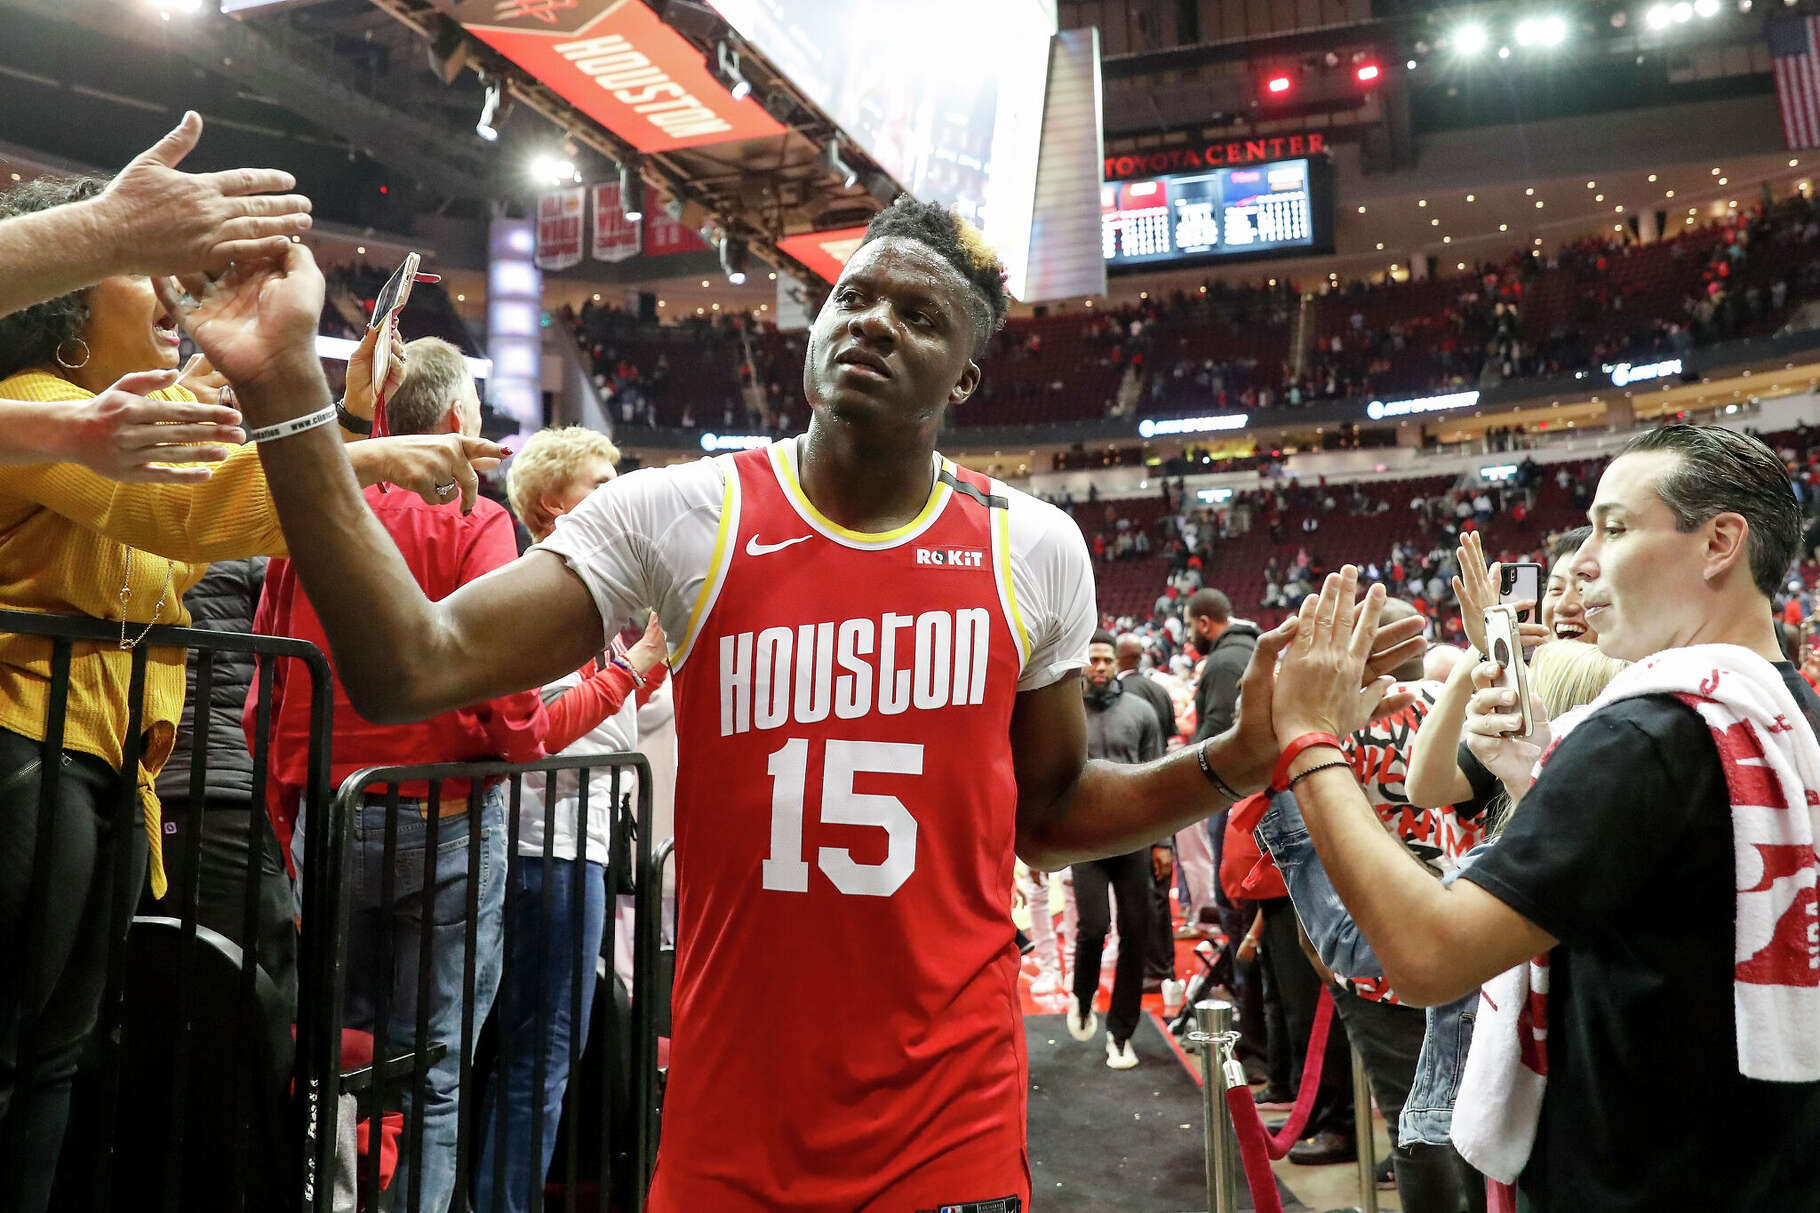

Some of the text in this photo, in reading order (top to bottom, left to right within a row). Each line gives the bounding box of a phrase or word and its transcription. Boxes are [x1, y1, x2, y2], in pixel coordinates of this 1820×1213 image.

[553, 34, 733, 138] HOUSTON
[1104, 133, 1324, 177] TOYOTA CENTER
[762, 737, 924, 897] 15
